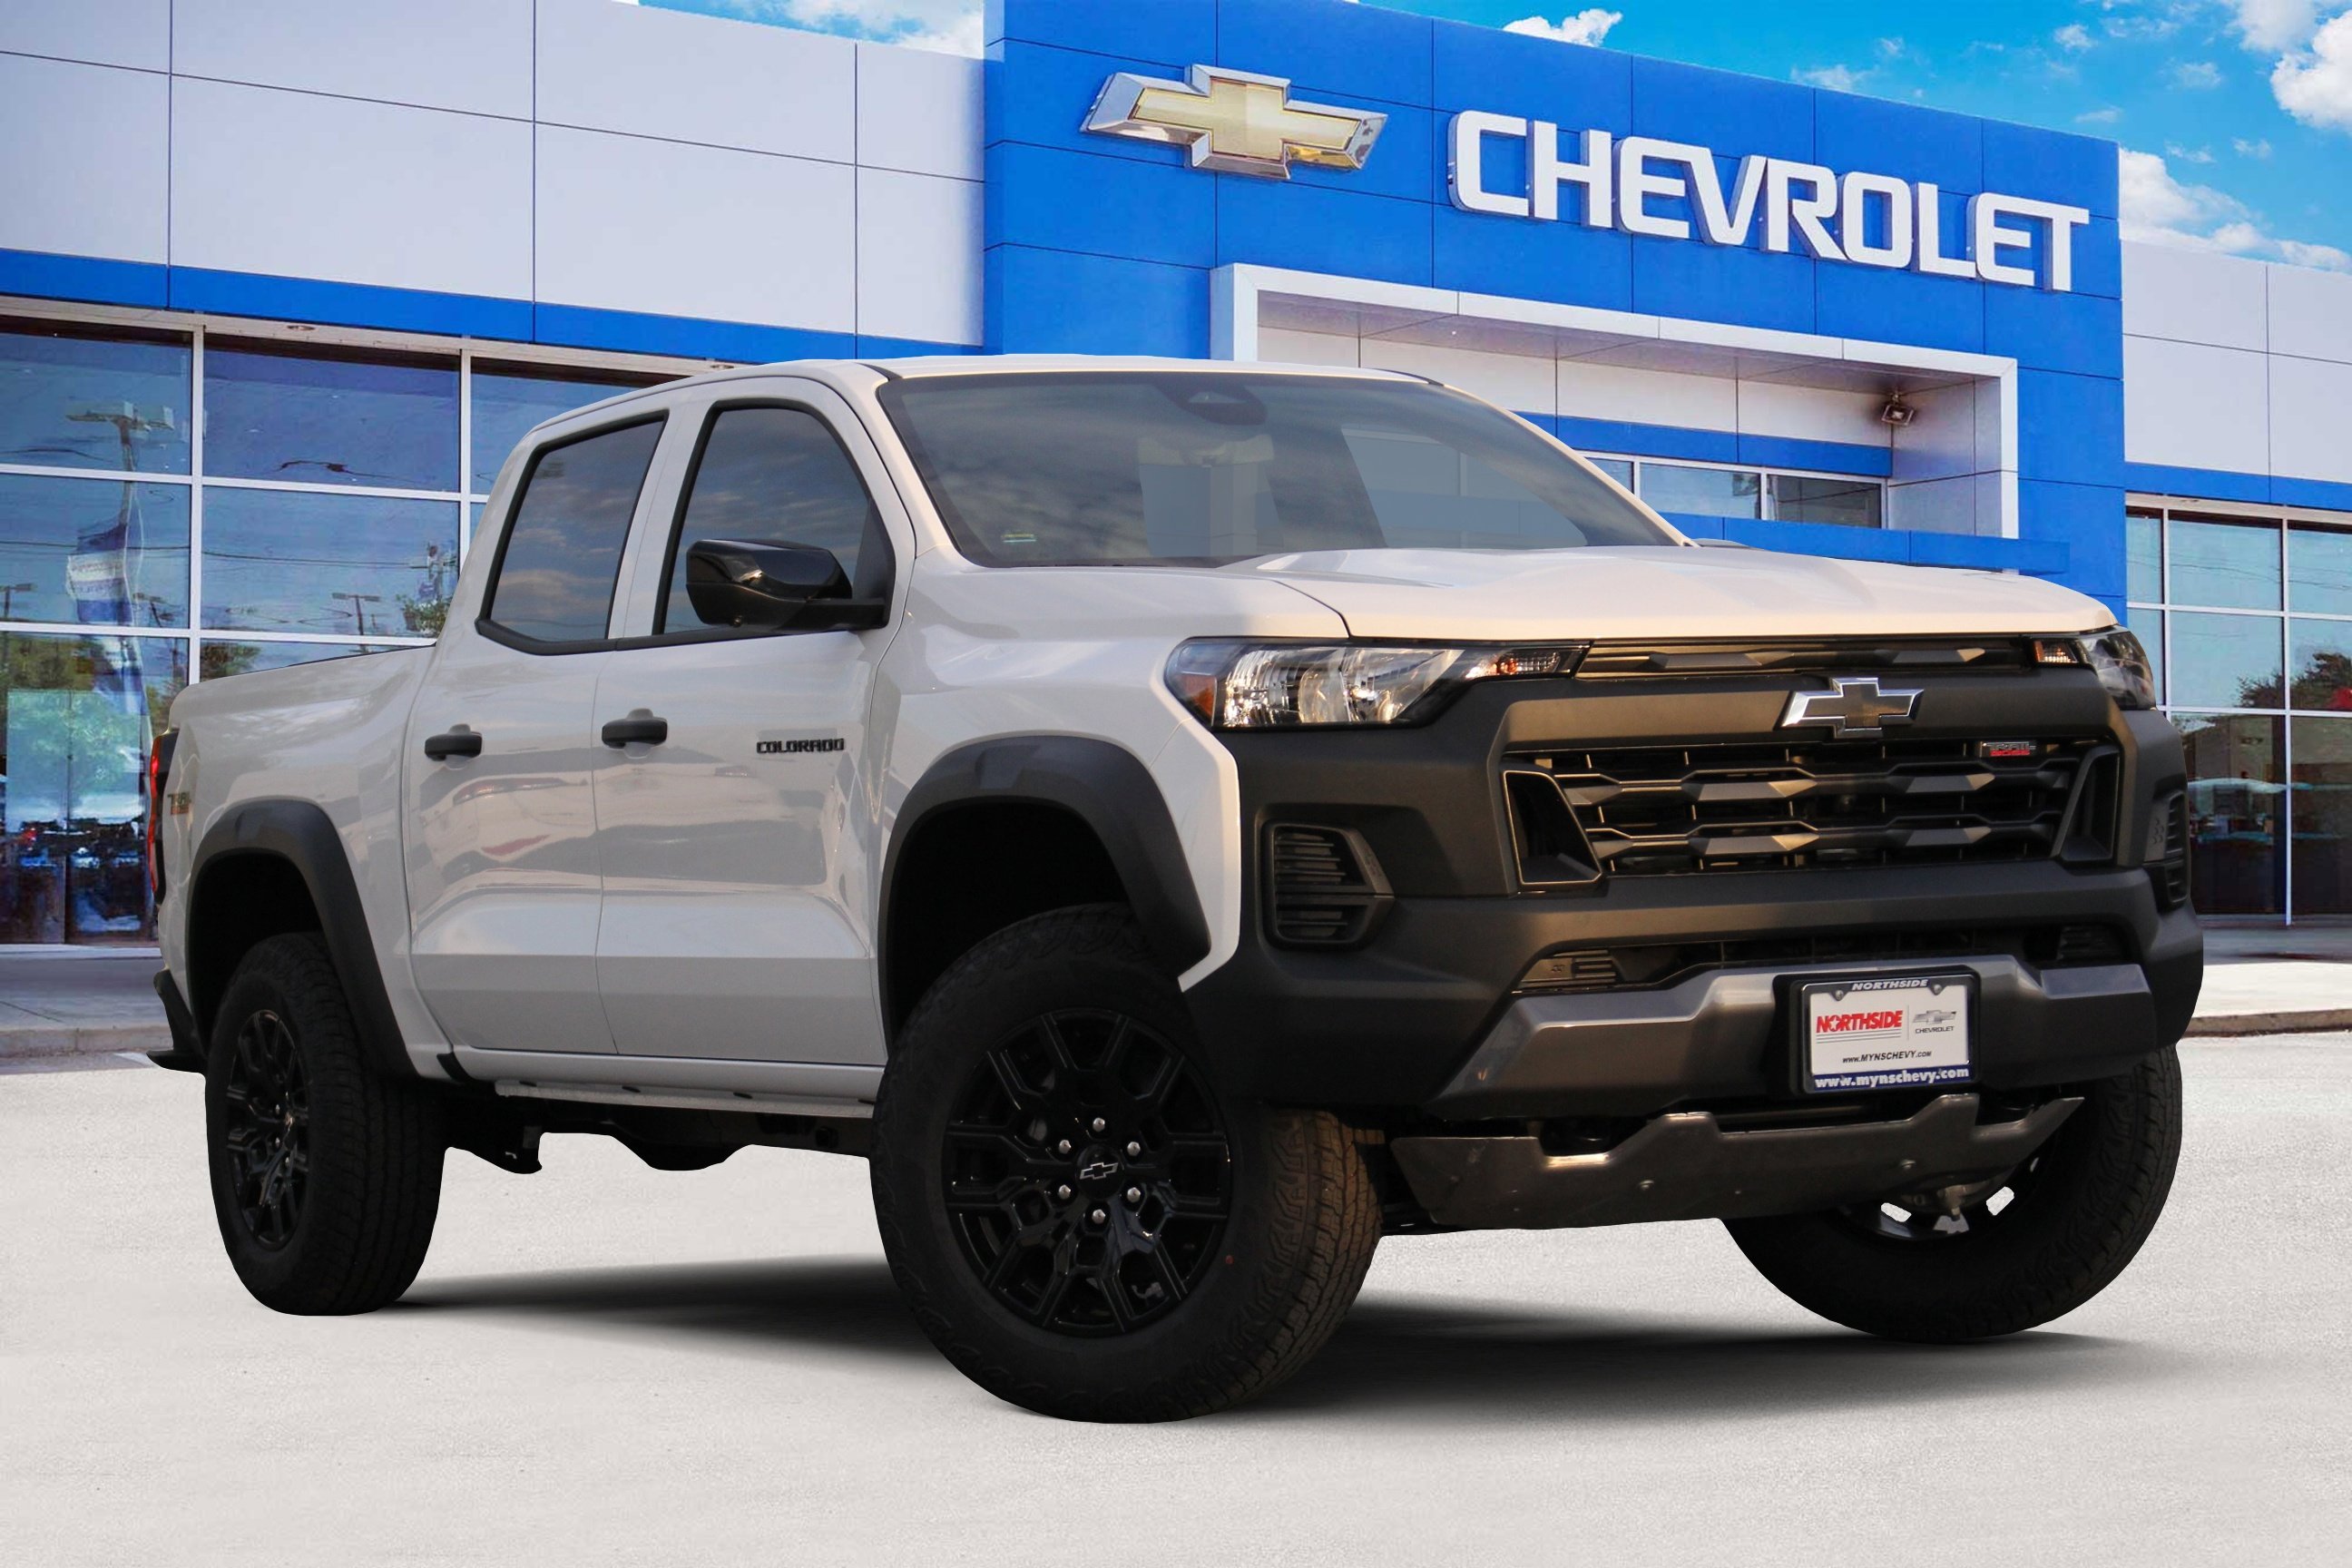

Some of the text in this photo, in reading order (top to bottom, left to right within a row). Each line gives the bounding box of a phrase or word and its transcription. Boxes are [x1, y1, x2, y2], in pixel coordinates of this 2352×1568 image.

[1448, 109, 2090, 292] CHEVROLET
[756, 738, 845, 754] COLORADO
[1852, 979, 1928, 991] NORTHSIDE
[1816, 1010, 1904, 1033] NORTHSIDE
[1915, 1025, 1955, 1034] CHEVROLET
[1815, 1068, 1969, 1088] www.mynschevy.com
